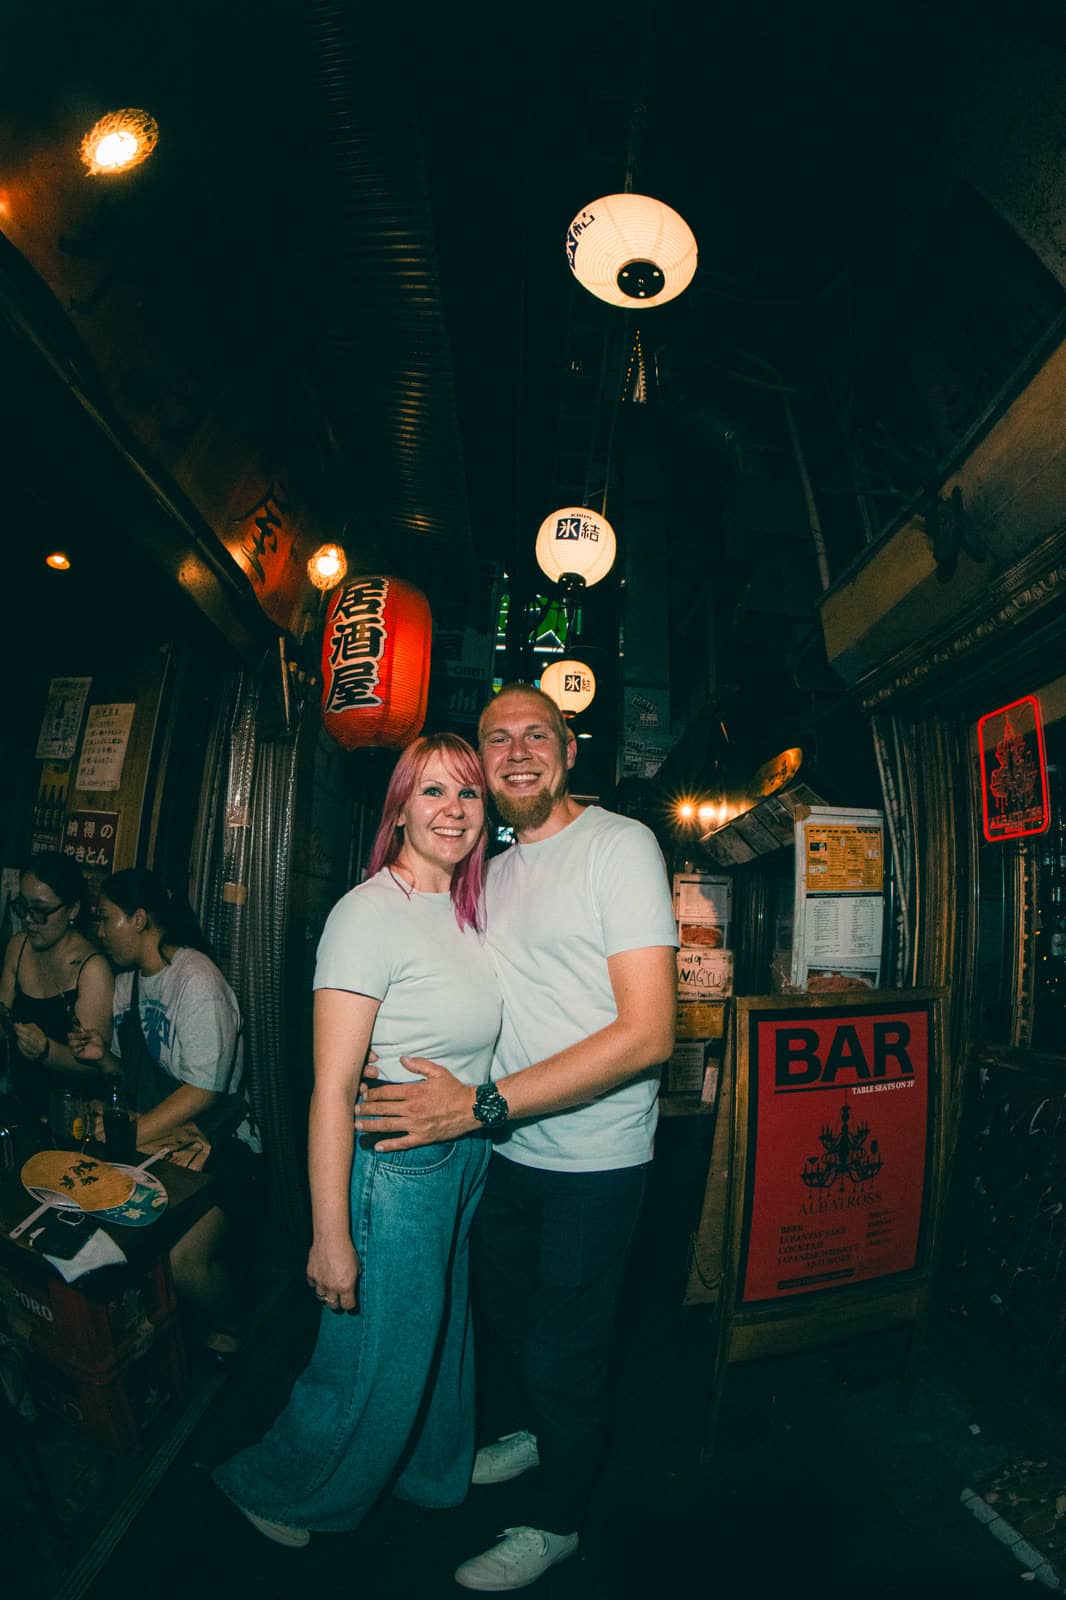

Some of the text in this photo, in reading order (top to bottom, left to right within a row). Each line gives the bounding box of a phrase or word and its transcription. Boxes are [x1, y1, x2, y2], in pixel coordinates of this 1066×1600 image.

[557, 518, 600, 542] 氷結
[324, 577, 388, 714] 居酒屋
[63, 844, 109, 866] やきとん
[775, 1021, 914, 1087] BAR
[852, 1085, 875, 1095] TABLE
[874, 1082, 896, 1093] SEATS
[896, 1080, 907, 1089] ON
